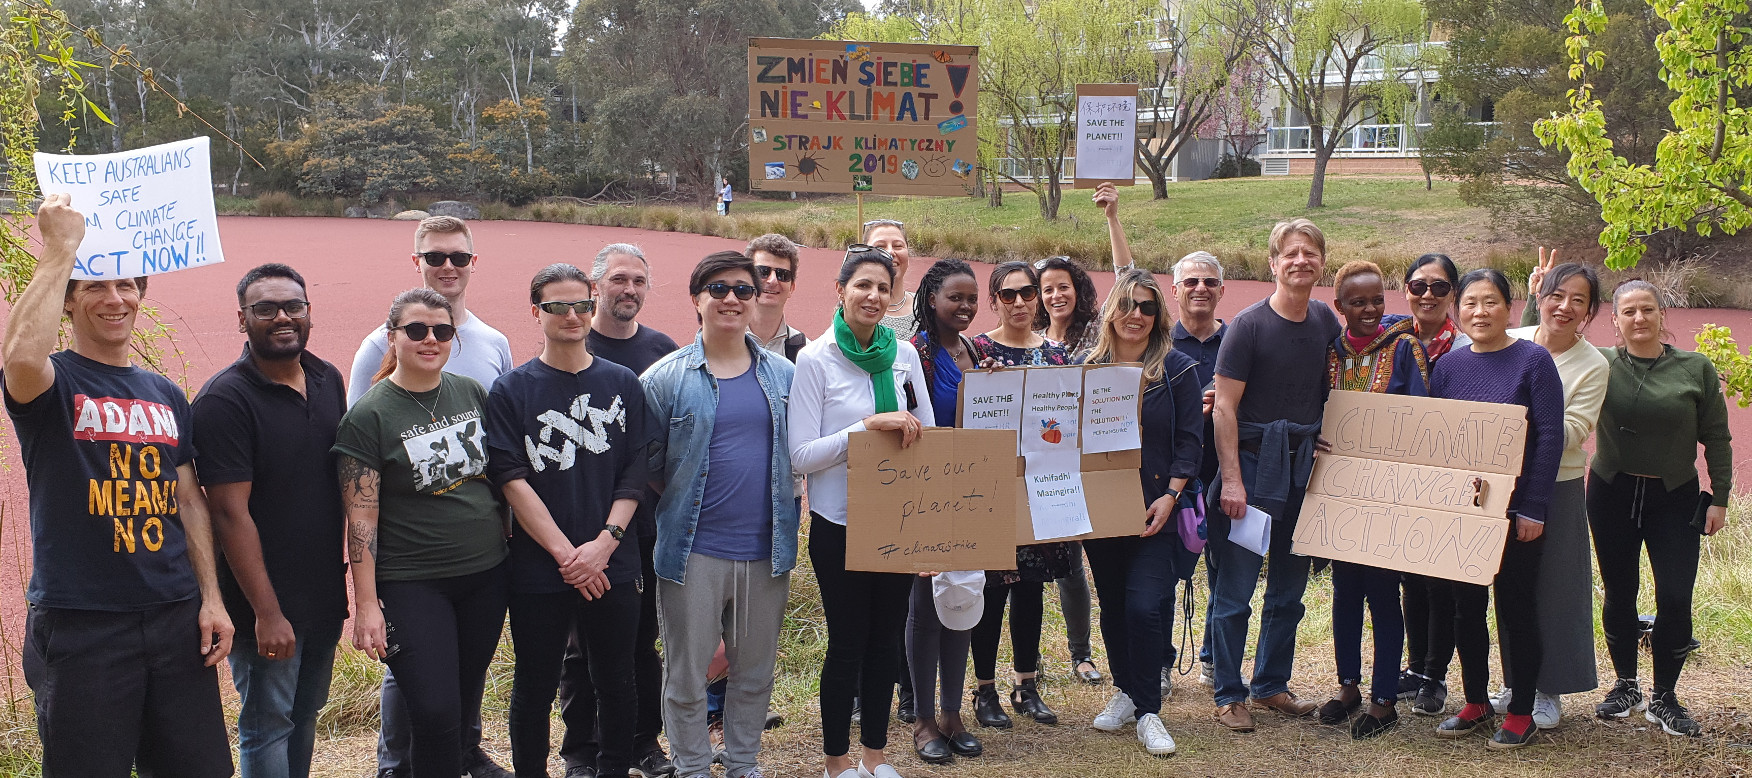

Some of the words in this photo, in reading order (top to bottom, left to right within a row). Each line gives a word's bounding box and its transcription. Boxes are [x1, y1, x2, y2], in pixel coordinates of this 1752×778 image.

[760, 86, 809, 119] NIE
[826, 86, 939, 121] KLIMAT
[1086, 119, 1108, 127] SAVE
[1109, 119, 1125, 127] THE
[772, 134, 844, 151] STRAJK
[854, 134, 956, 153] KLIMATYCZNY
[1086, 132, 1123, 141] PLANET!!
[47, 161, 97, 185] KEEP
[104, 147, 195, 184] AUSTRALIANS
[848, 153, 898, 174] 2019
[98, 185, 142, 207] SAFE
[115, 200, 178, 231] CLIMATE
[132, 219, 198, 250] CHANGE
[972, 395, 994, 405] SAVE
[1032, 391, 1060, 400] Healthy
[1061, 390, 1079, 398] Plt
[1091, 396, 1120, 405] SOLUTION
[972, 408, 1010, 419] PLANET!!
[1031, 404, 1056, 412] Healthy
[1056, 403, 1078, 412] People
[1091, 407, 1102, 415] THE
[400, 424, 427, 441] safe
[427, 415, 450, 432] and
[450, 406, 481, 424] sound
[1335, 405, 1524, 468] CLIMATE
[109, 443, 161, 480] NO
[1033, 471, 1071, 484] Kuhifadhi
[1322, 458, 1482, 507] CHANGE
[88, 478, 178, 517] MEANS
[1036, 485, 1080, 498] Mazingira!!
[113, 516, 165, 554] NO
